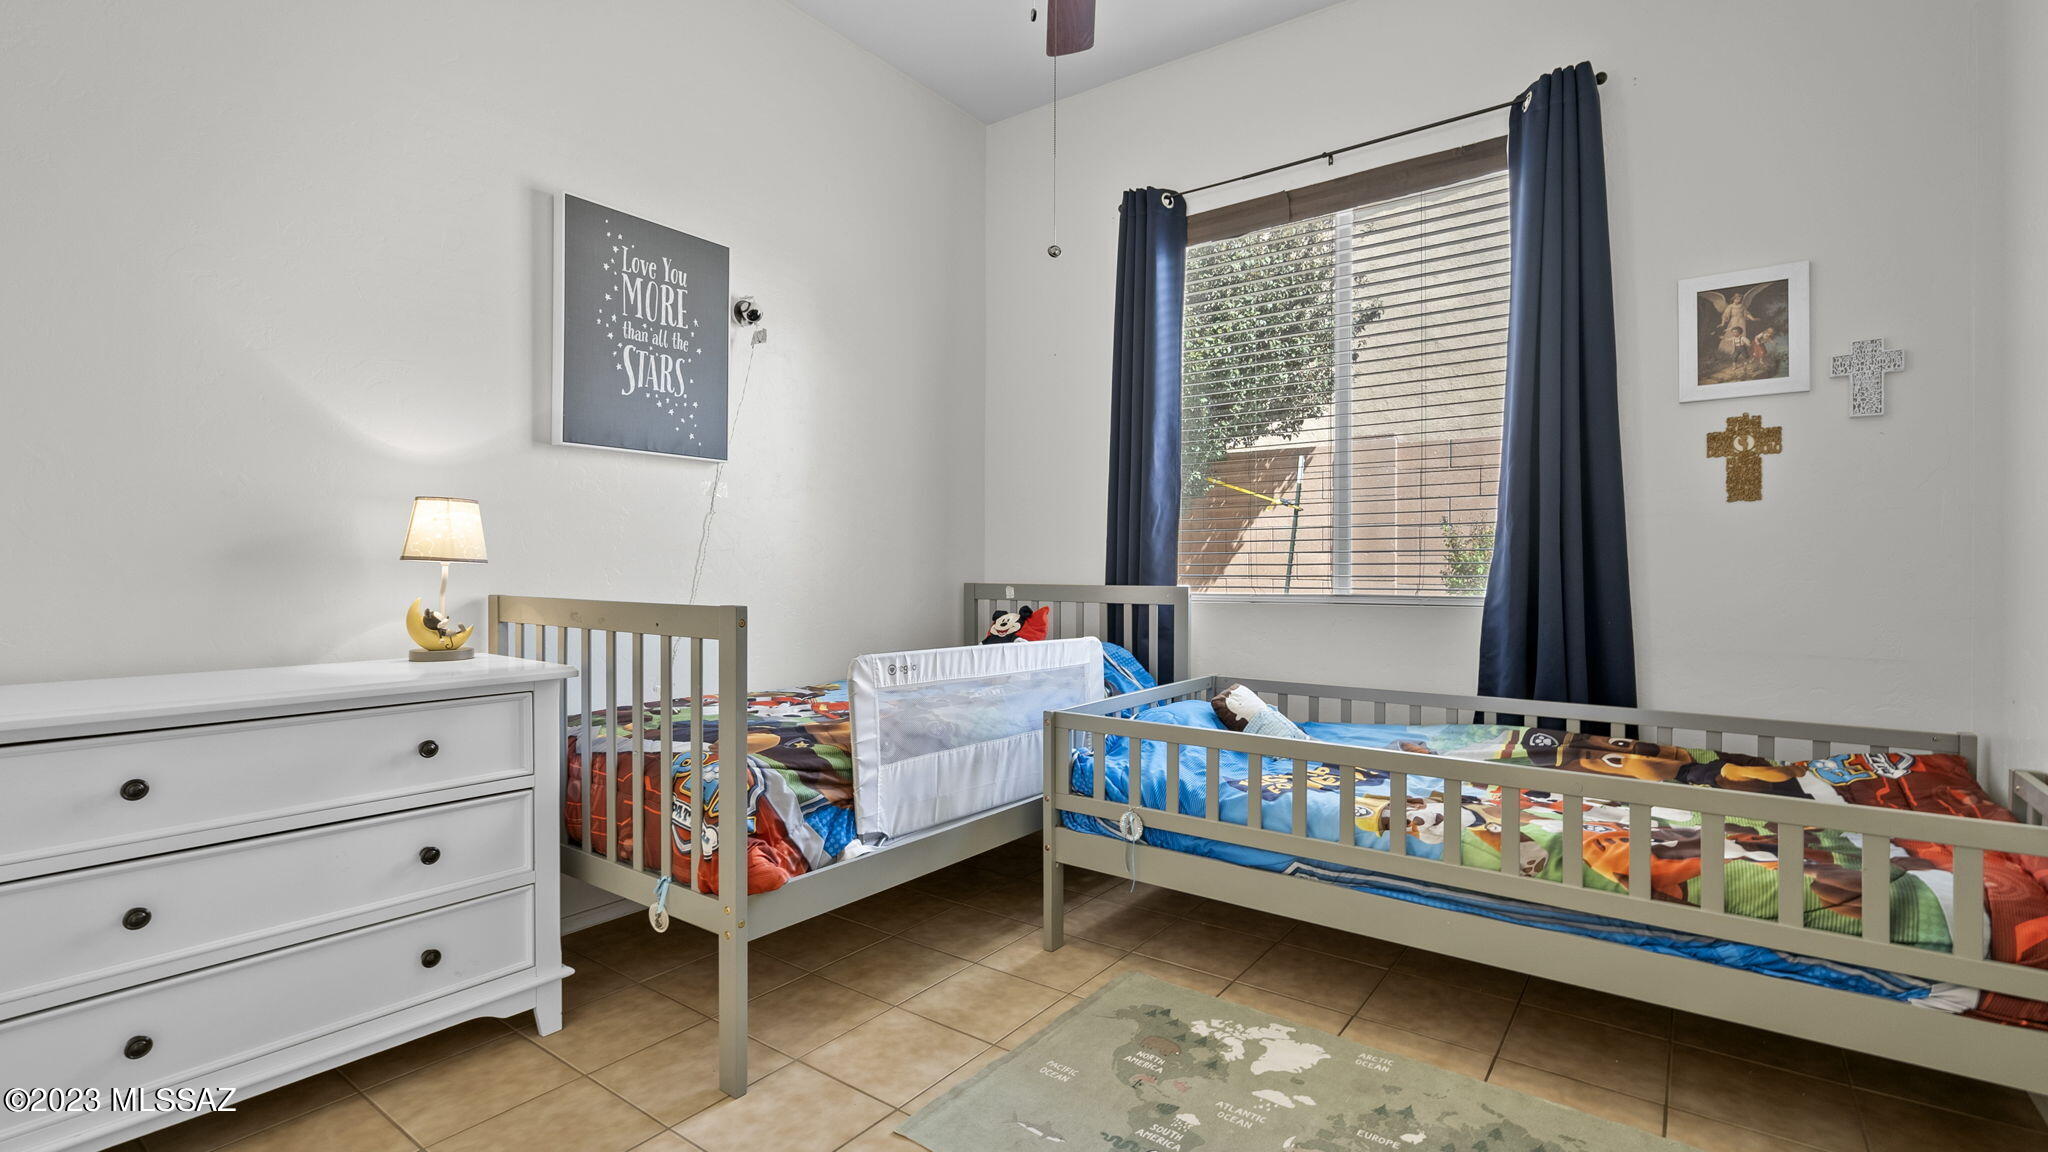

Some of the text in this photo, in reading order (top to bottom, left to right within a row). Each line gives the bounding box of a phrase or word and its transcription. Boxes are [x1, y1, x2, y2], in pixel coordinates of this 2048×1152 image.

[621, 245, 688, 288] Love You
[621, 272, 689, 329] MORE
[622, 320, 689, 352] than all the
[621, 345, 685, 397] STARS
[1123, 1055, 1164, 1074] AMERICA
[1136, 1050, 1167, 1066] NORTH
[1355, 1059, 1390, 1073] OCEAN
[1357, 1053, 1395, 1067] ARCTIC
[1039, 1067, 1071, 1083] OCEAN
[1046, 1060, 1080, 1078] PACIFIC
[1215, 1101, 1268, 1125] ATLANTIC
[1216, 1112, 1253, 1129] OCEAN
[1134, 1128, 1182, 1152] AMERICA
[1149, 1123, 1184, 1142] SOUTH
[1356, 1129, 1401, 1150] EUROPE
